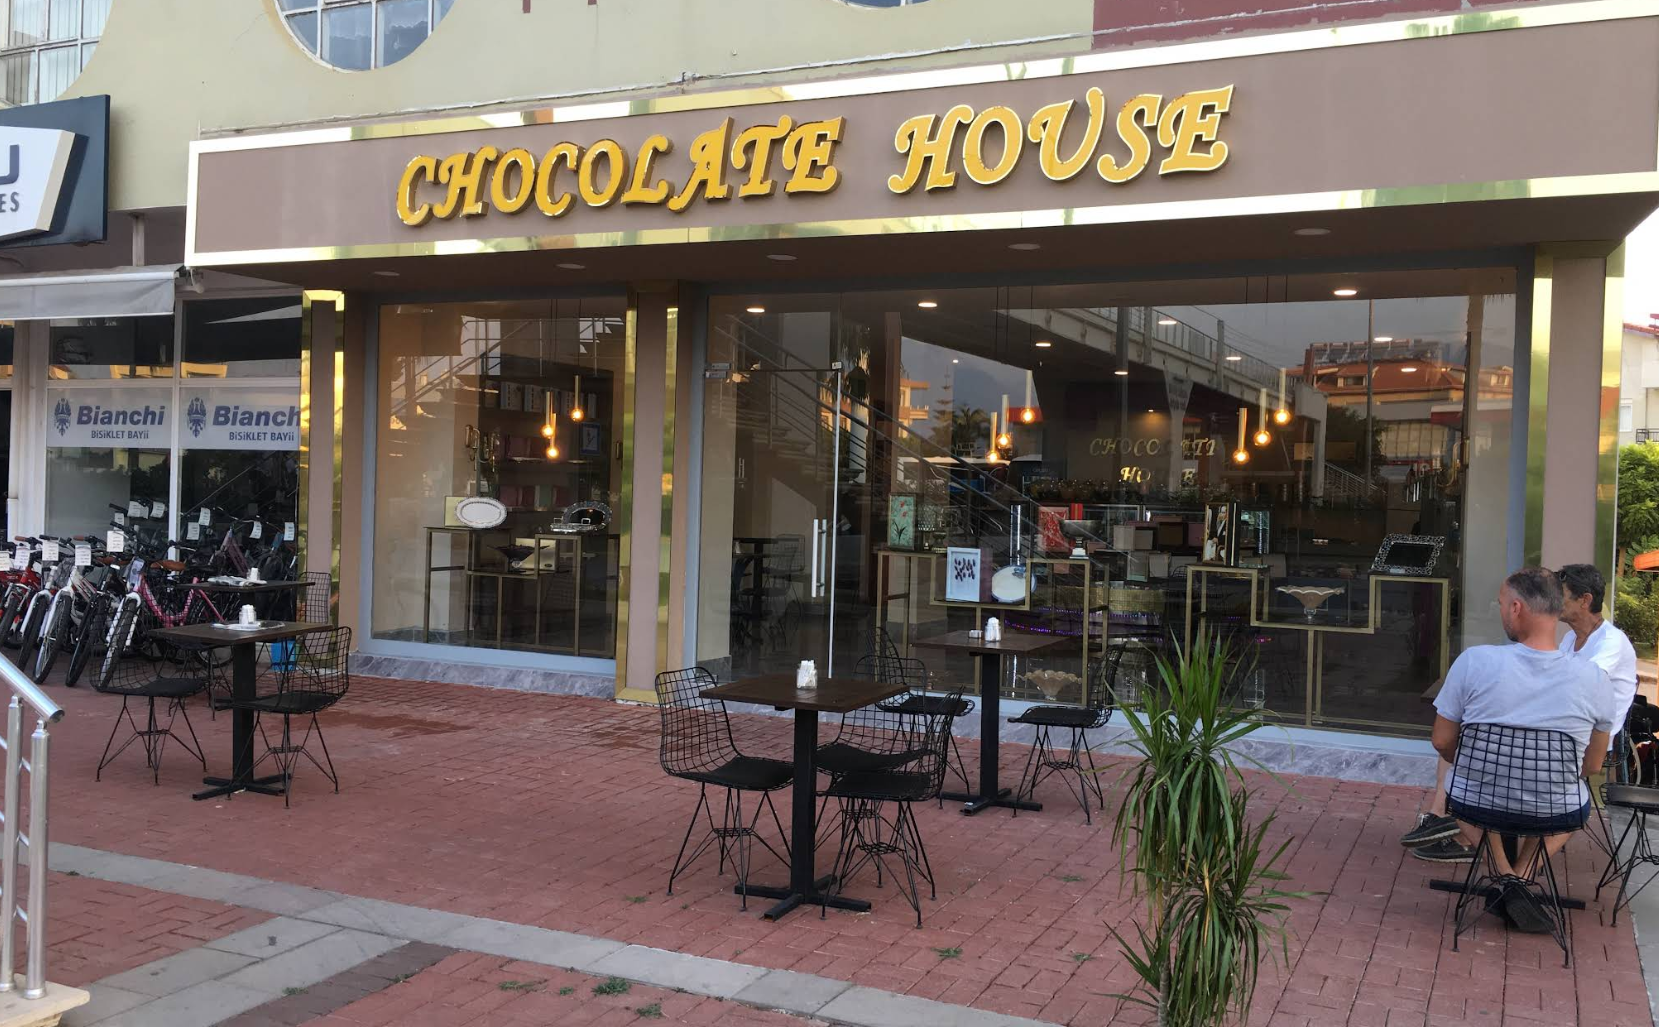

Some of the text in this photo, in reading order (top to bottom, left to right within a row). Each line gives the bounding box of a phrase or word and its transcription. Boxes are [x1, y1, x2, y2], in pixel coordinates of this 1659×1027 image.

[396, 84, 1235, 227] CHOCOLATE HOUSE
[76, 405, 166, 426] Bianchi
[1089, 437, 1217, 457] CHOCOT
[1120, 465, 1198, 484] HOE
